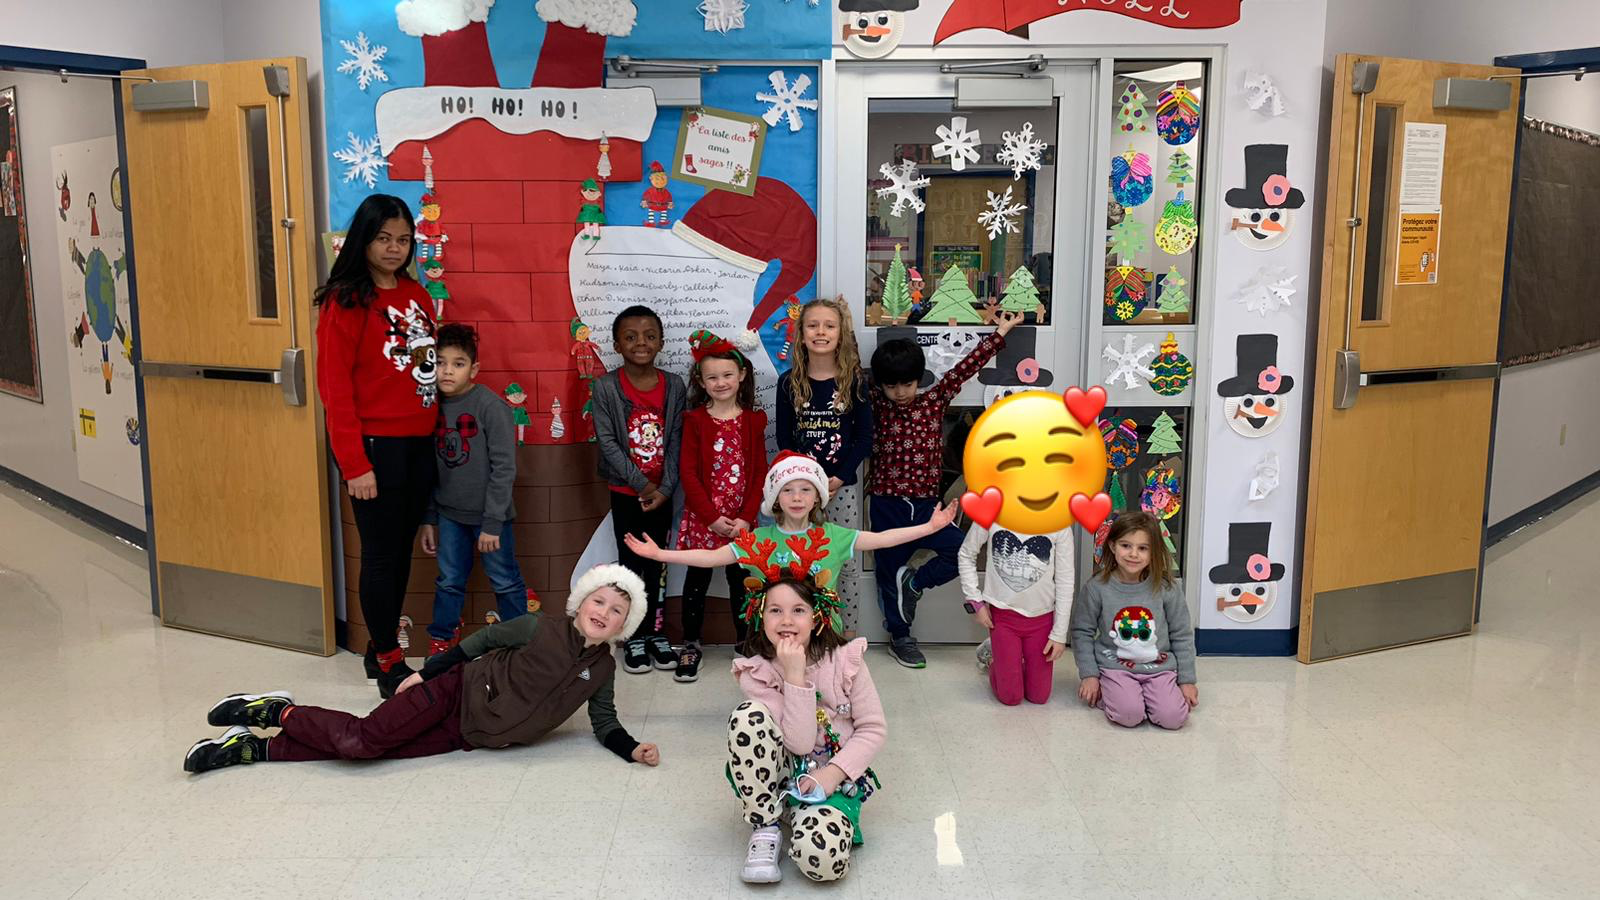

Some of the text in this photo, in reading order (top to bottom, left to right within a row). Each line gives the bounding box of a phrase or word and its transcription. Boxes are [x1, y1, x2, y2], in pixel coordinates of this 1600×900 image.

[441, 96, 474, 114] HO!
[491, 96, 523, 117] HO!
[711, 127, 730, 140] liste
[730, 132, 746, 143] des
[707, 143, 730, 154] amis
[699, 156, 724, 169] sages
[1402, 218, 1424, 226] Protégez
[806, 430, 827, 438] STUFF
